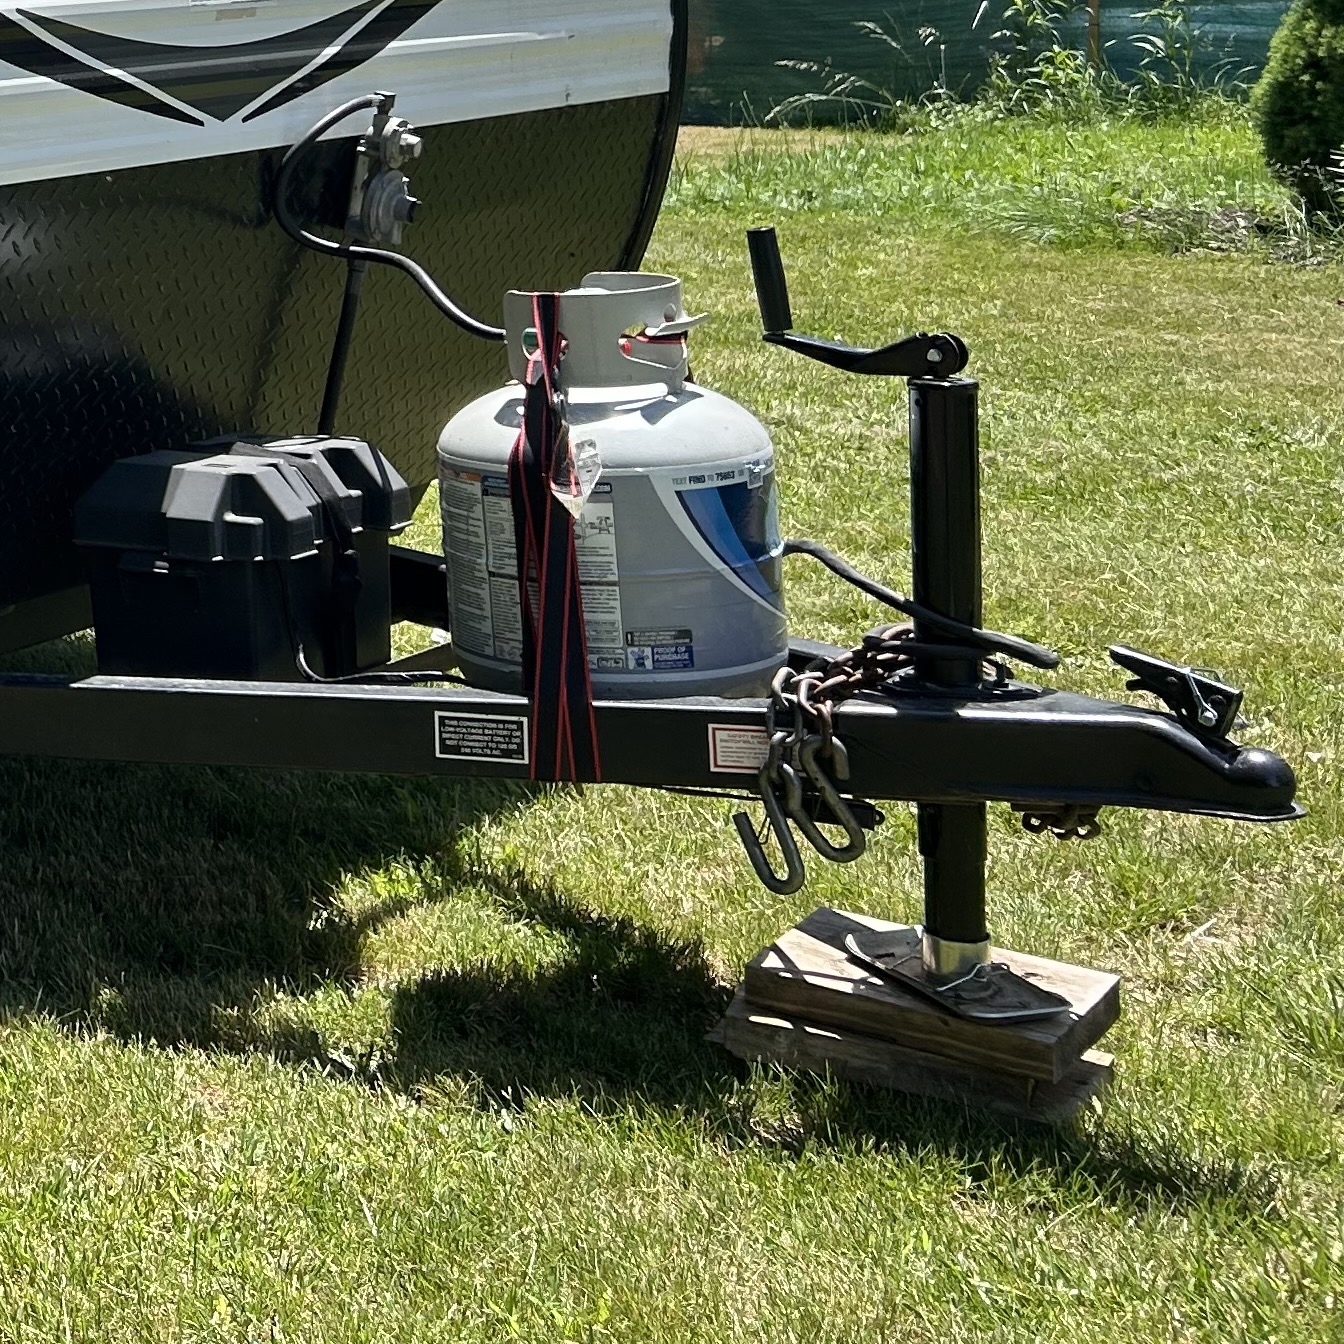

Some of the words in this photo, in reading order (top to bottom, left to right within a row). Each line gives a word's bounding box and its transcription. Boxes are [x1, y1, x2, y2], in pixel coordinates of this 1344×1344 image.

[653, 646, 676, 654] PROOF
[677, 645, 686, 653] OF
[653, 652, 690, 662] PURCHASE
[484, 728, 512, 736] BATTERY
